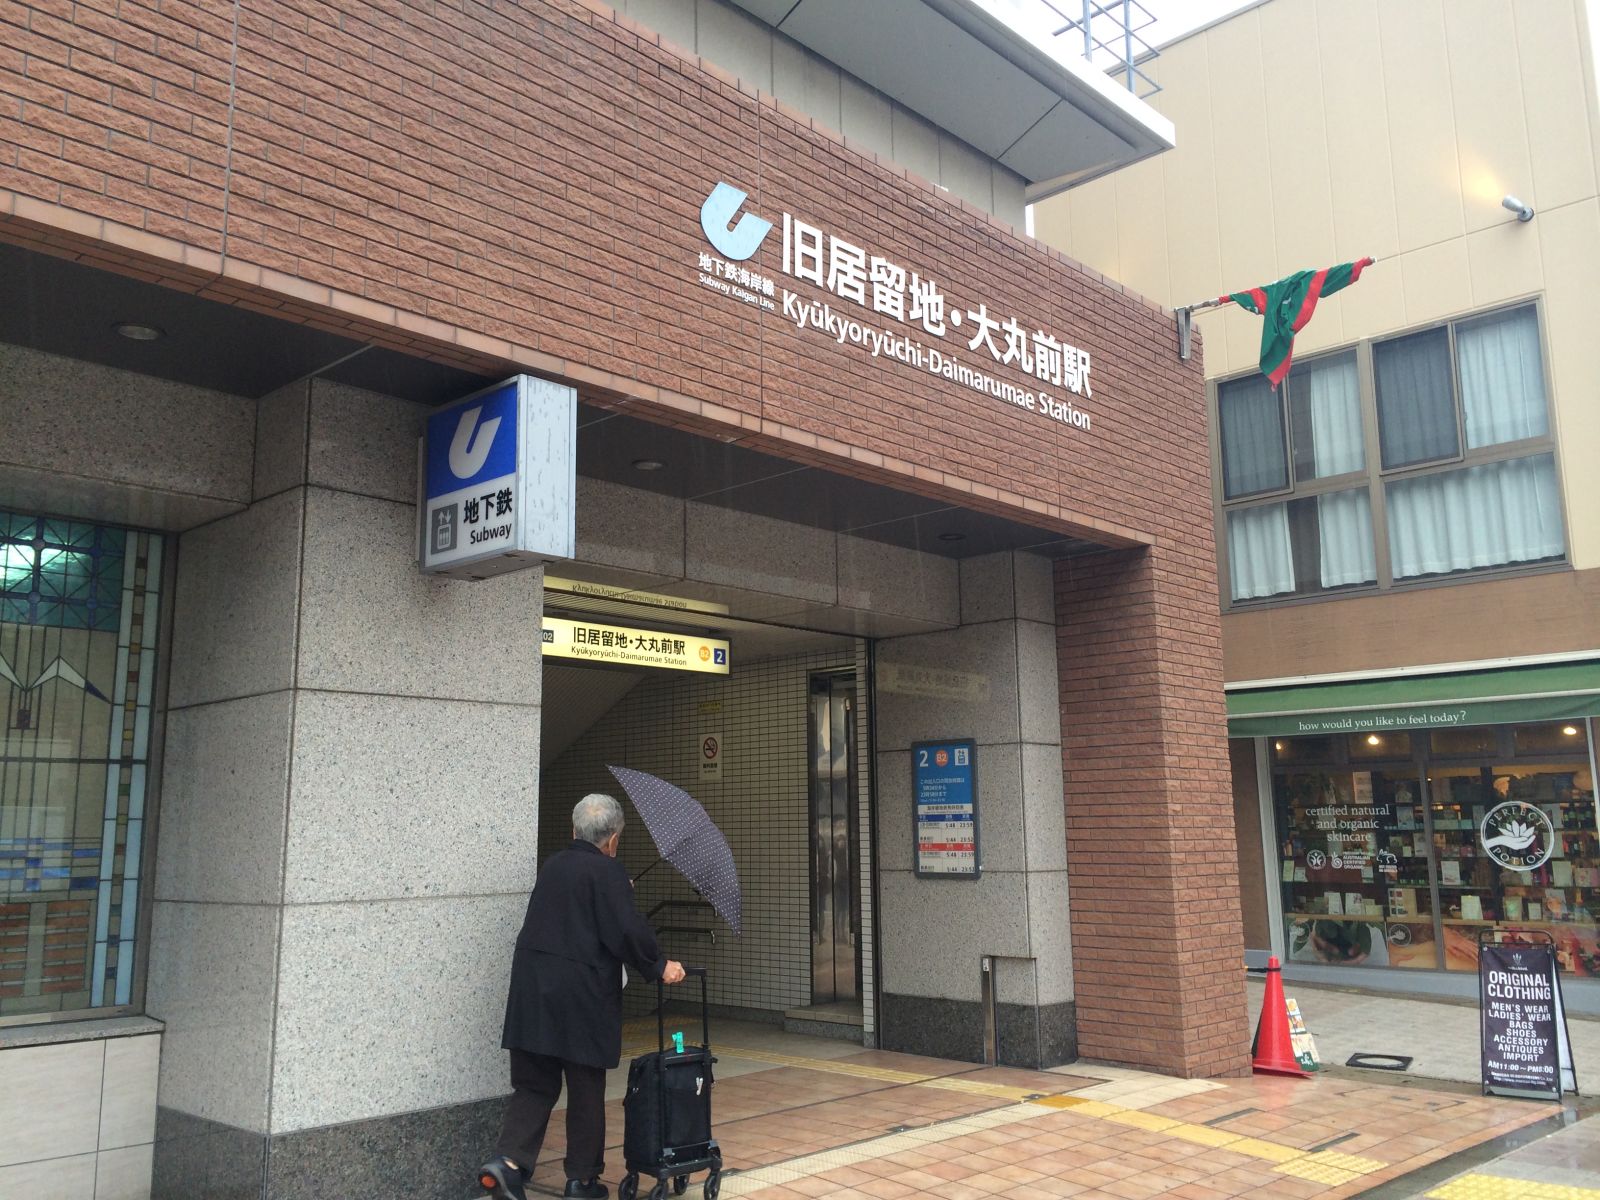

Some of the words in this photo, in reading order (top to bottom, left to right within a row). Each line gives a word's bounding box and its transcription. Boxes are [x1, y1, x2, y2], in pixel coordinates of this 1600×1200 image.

[698, 252, 774, 297] 地下鉄海岸線
[698, 273, 731, 294] Subway
[731, 285, 758, 306] Kaigan
[759, 295, 775, 311] Line
[783, 211, 1092, 399] 旧居留地・大丸前駅
[783, 289, 1035, 410] Kyūkyoryūchi-Daimarumae
[1039, 392, 1091, 431] Station
[463, 487, 513, 525] 地下鉄
[470, 522, 513, 545] Subway
[573, 626, 686, 656] 旧居留地・大丸前駅
[571, 645, 663, 664] Kyūkyoryūchi-Daimarumae
[664, 656, 687, 667] Station
[716, 650, 723, 663] 2
[1299, 721, 1319, 731] how
[1322, 718, 1352, 729] would
[1354, 719, 1373, 730] you
[1375, 715, 1394, 726] like
[1396, 716, 1406, 725] to
[1409, 714, 1427, 724] feel
[1430, 710, 1466, 723] today?
[920, 750, 929, 767] 2
[1305, 804, 1348, 816] certified
[1351, 803, 1390, 816] natural
[1488, 806, 1545, 826] PERFECT
[1317, 818, 1337, 829] and
[1340, 818, 1380, 832] organic
[1327, 830, 1372, 842] skincare
[1493, 847, 1545, 865] POTION
[1489, 970, 1550, 987] ORIGINAL
[1487, 985, 1551, 1000] CLOTHING
[1488, 1010, 1524, 1021] LADIES'
[1528, 1013, 1551, 1021] WEAR
[1491, 1002, 1521, 1012] MEN'S
[1524, 1005, 1549, 1014] WEAR
[1506, 1028, 1537, 1037] SHOES
[1509, 1021, 1534, 1029] BAGS
[1494, 1034, 1548, 1046] ACCESSORY
[1498, 1043, 1544, 1054] ANTIQUES
[1503, 1052, 1539, 1062] IMPORT
[1488, 1060, 1519, 1071] AM11:00
